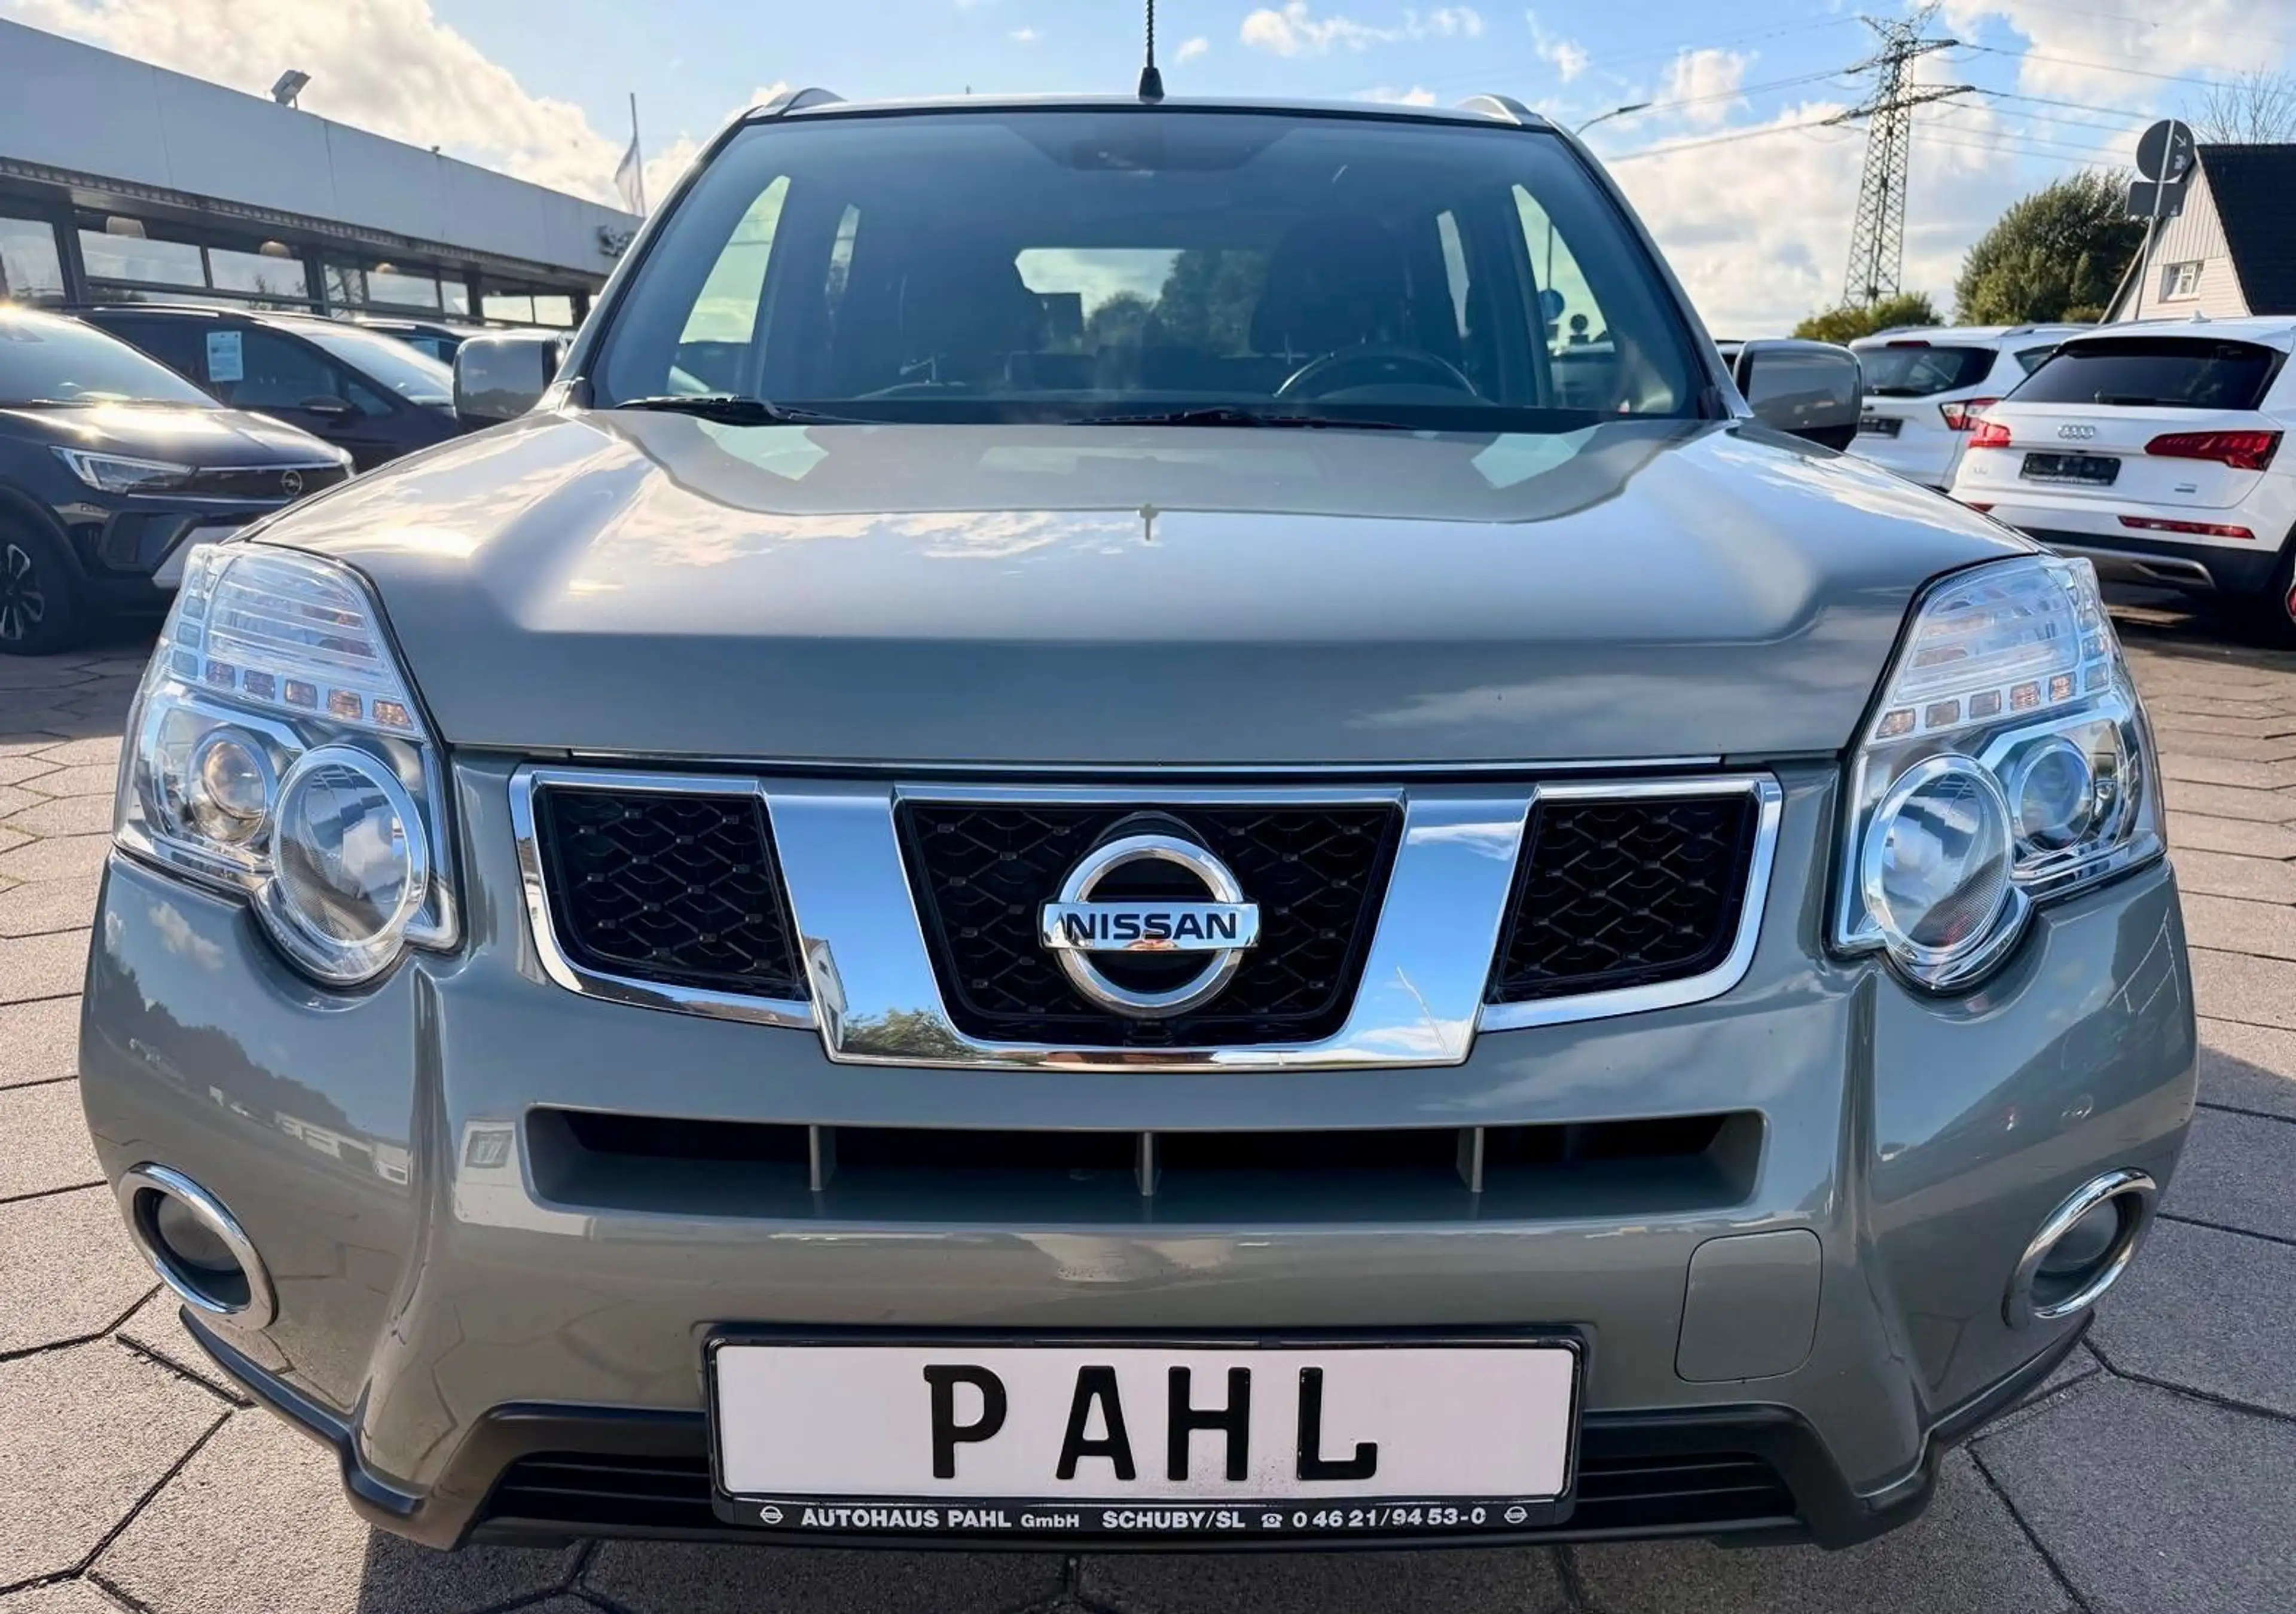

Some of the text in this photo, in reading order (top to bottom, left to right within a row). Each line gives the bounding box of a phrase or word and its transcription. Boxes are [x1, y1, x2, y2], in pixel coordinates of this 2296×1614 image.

[1065, 913, 1236, 940] NISSAN
[801, 1508, 940, 1528] AUTOHAUS
[948, 1510, 1012, 1528] PAHL
[1021, 1513, 1080, 1528] GmbH
[1102, 1510, 1246, 1529] SCHUBY/SL
